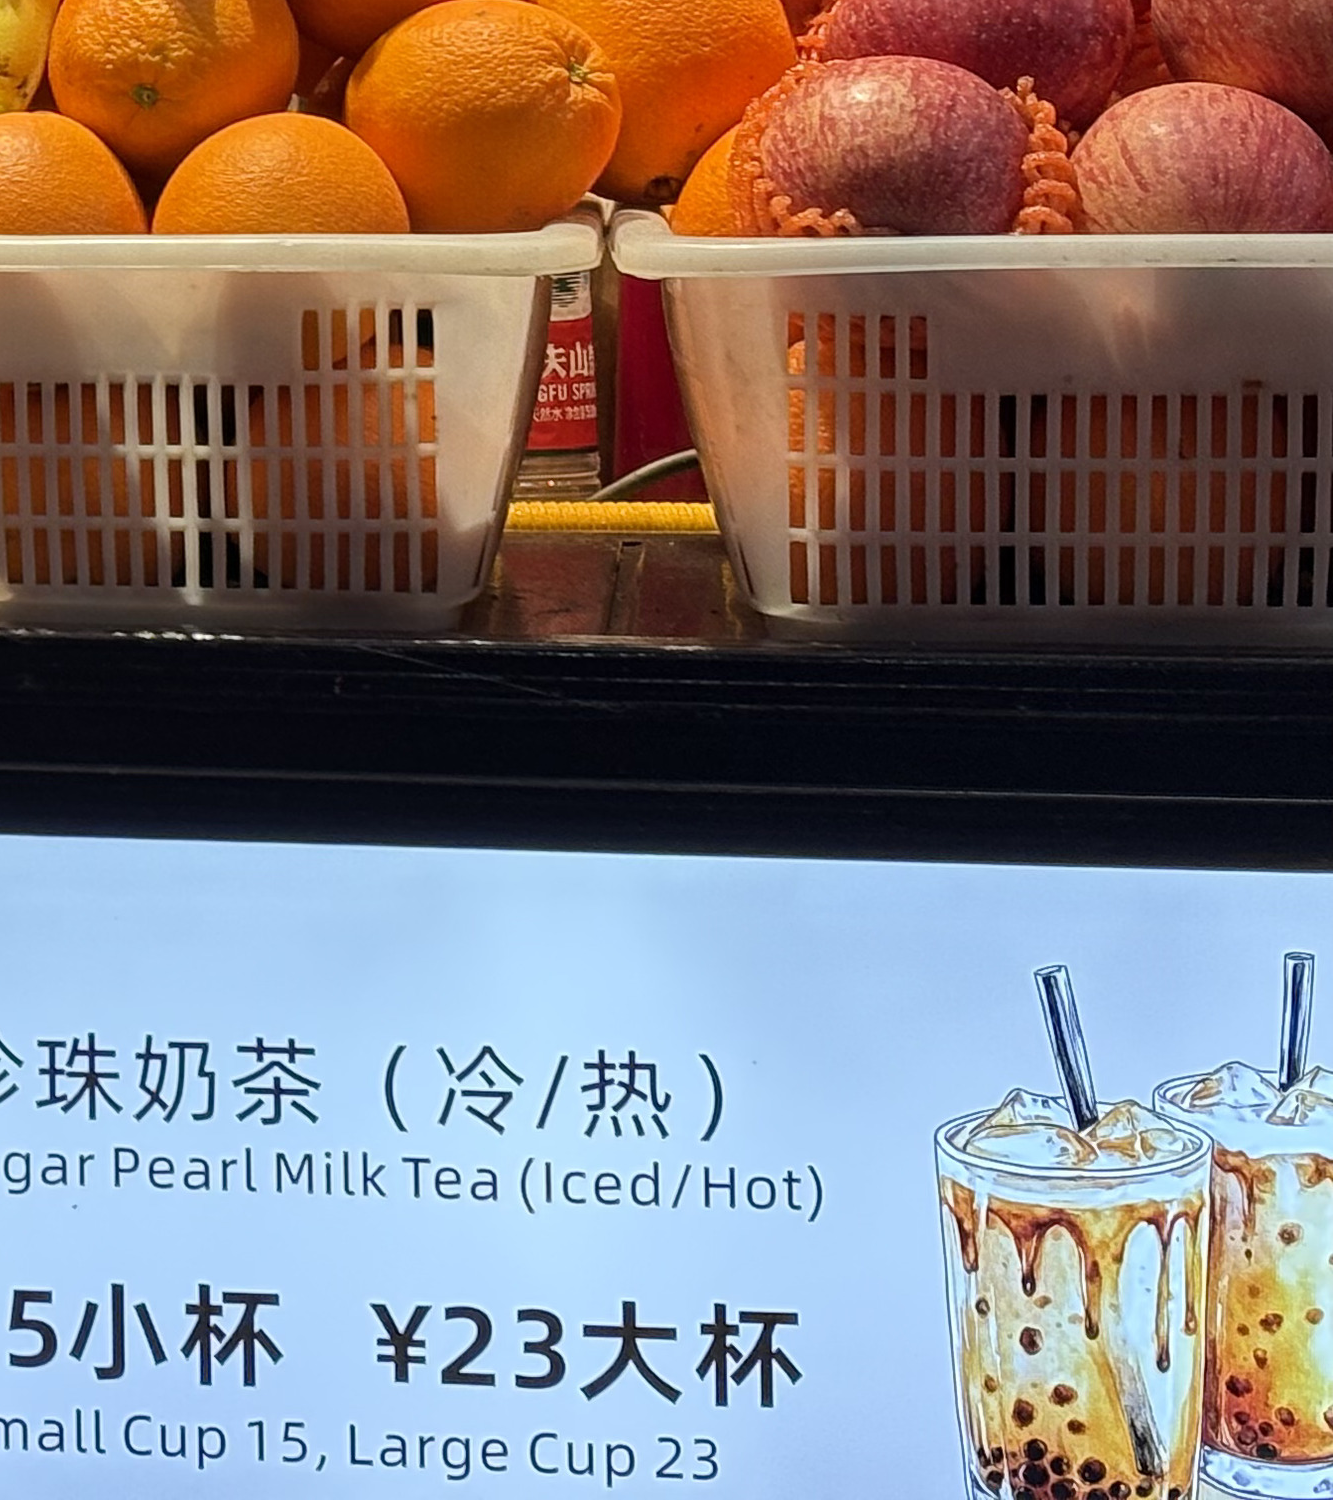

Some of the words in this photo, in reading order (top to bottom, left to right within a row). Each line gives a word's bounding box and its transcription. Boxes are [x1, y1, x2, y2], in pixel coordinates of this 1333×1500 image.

[537, 384, 568, 403] GFU
[542, 342, 595, 379] 夫山
[113, 1147, 258, 1193] Pearl
[275, 1150, 387, 1198] Milk
[401, 1156, 498, 1202] Tea
[520, 1157, 824, 1223] (Iced/Hot)
[369, 1300, 803, 1409] ¥23大杯
[123, 1414, 227, 1470] Cup
[247, 1420, 327, 1472] 15,
[349, 1423, 509, 1481] Large
[529, 1432, 636, 1488] Cup
[655, 1436, 720, 1481] 23
